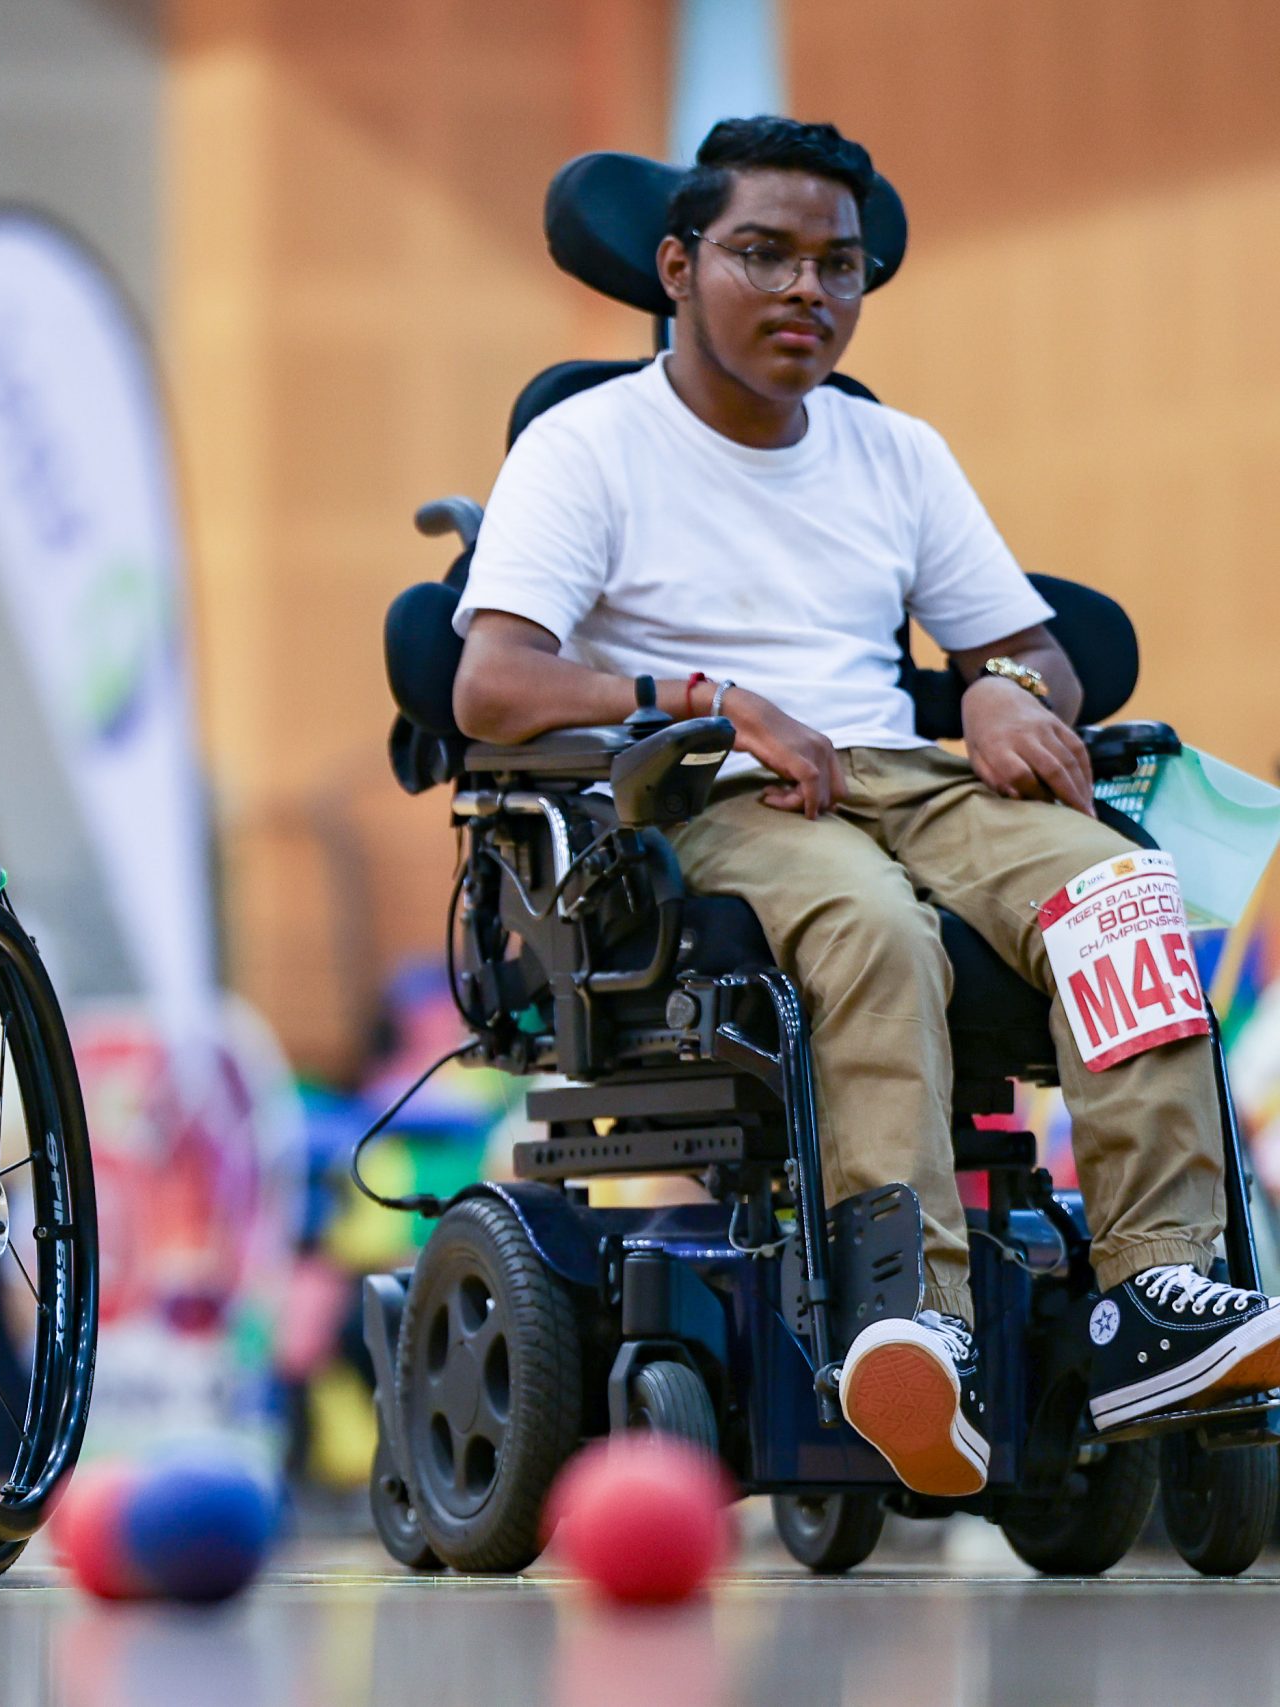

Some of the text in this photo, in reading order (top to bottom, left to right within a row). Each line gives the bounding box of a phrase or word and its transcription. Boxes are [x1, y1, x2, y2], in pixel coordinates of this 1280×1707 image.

[1065, 902, 1103, 930] TIGER
[1106, 884, 1151, 907] BALM
[1068, 933, 1202, 1048] M45
